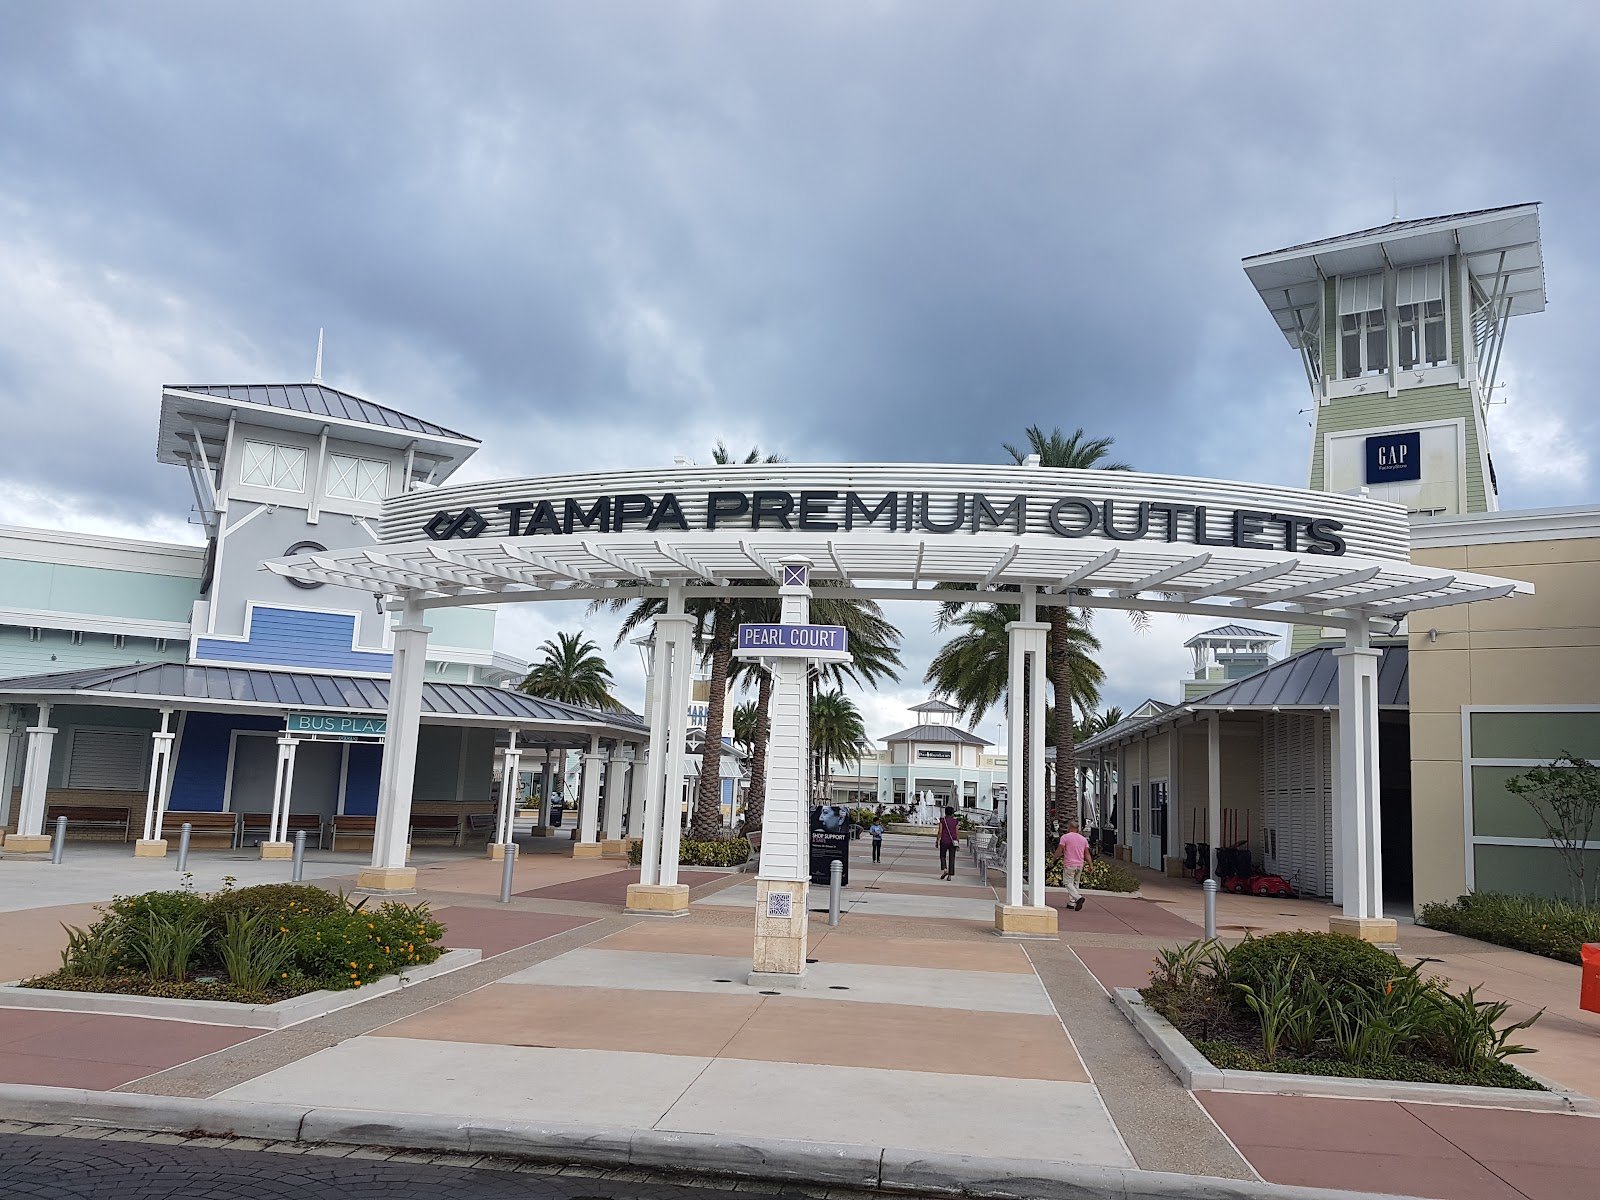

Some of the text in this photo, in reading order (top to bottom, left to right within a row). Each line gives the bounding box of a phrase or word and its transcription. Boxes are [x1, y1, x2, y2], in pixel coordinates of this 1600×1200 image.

[1378, 444, 1408, 465] GAP
[499, 490, 1347, 558] TAMPA PREMIUM OUTLETS
[745, 628, 837, 647] PEARL COURT
[299, 716, 335, 730] BUS
[824, 833, 846, 841] SUPPORT
